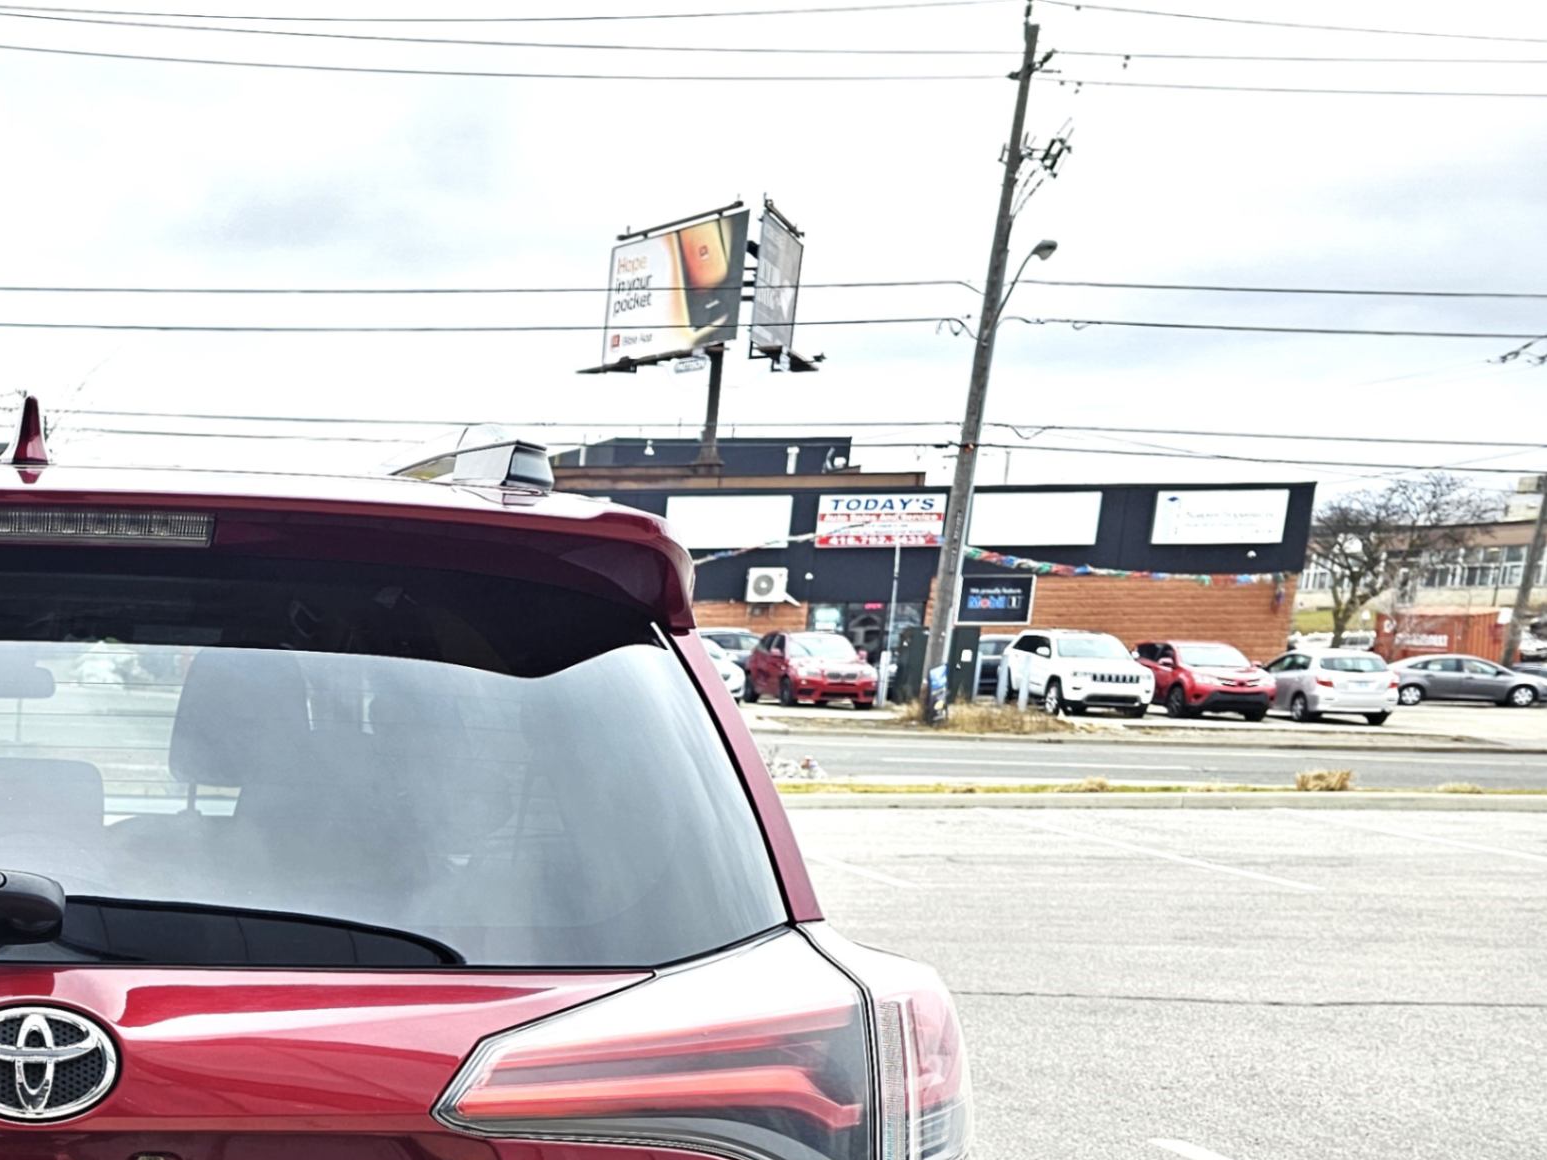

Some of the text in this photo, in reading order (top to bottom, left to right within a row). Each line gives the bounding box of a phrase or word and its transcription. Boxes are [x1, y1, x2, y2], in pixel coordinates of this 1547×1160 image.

[617, 255, 648, 274] Hope
[626, 274, 653, 297] your
[613, 292, 653, 316] pocket
[831, 498, 935, 511] TODAY'S
[967, 595, 1006, 609] Mobil
